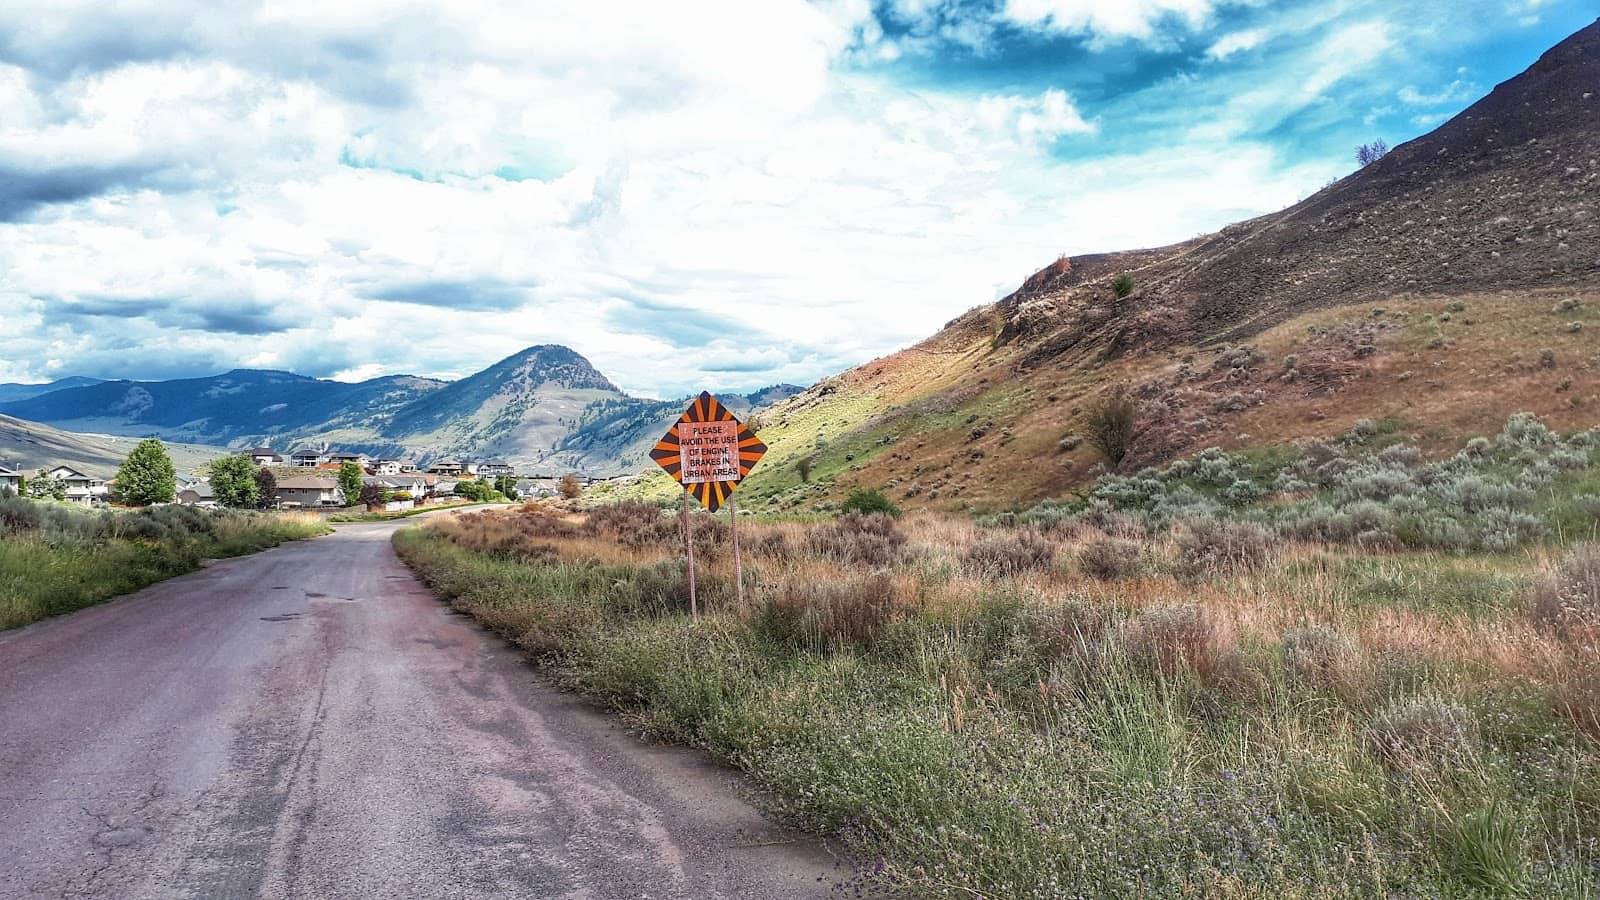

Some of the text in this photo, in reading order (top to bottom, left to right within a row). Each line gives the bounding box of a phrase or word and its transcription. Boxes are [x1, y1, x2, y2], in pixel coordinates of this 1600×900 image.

[693, 426, 722, 434] PLEASE
[681, 436, 736, 446] AVOID THE USE
[701, 447, 729, 455] ENGINE
[690, 457, 730, 466] BRAKES IN
[684, 468, 737, 478] URBAN AREAS
